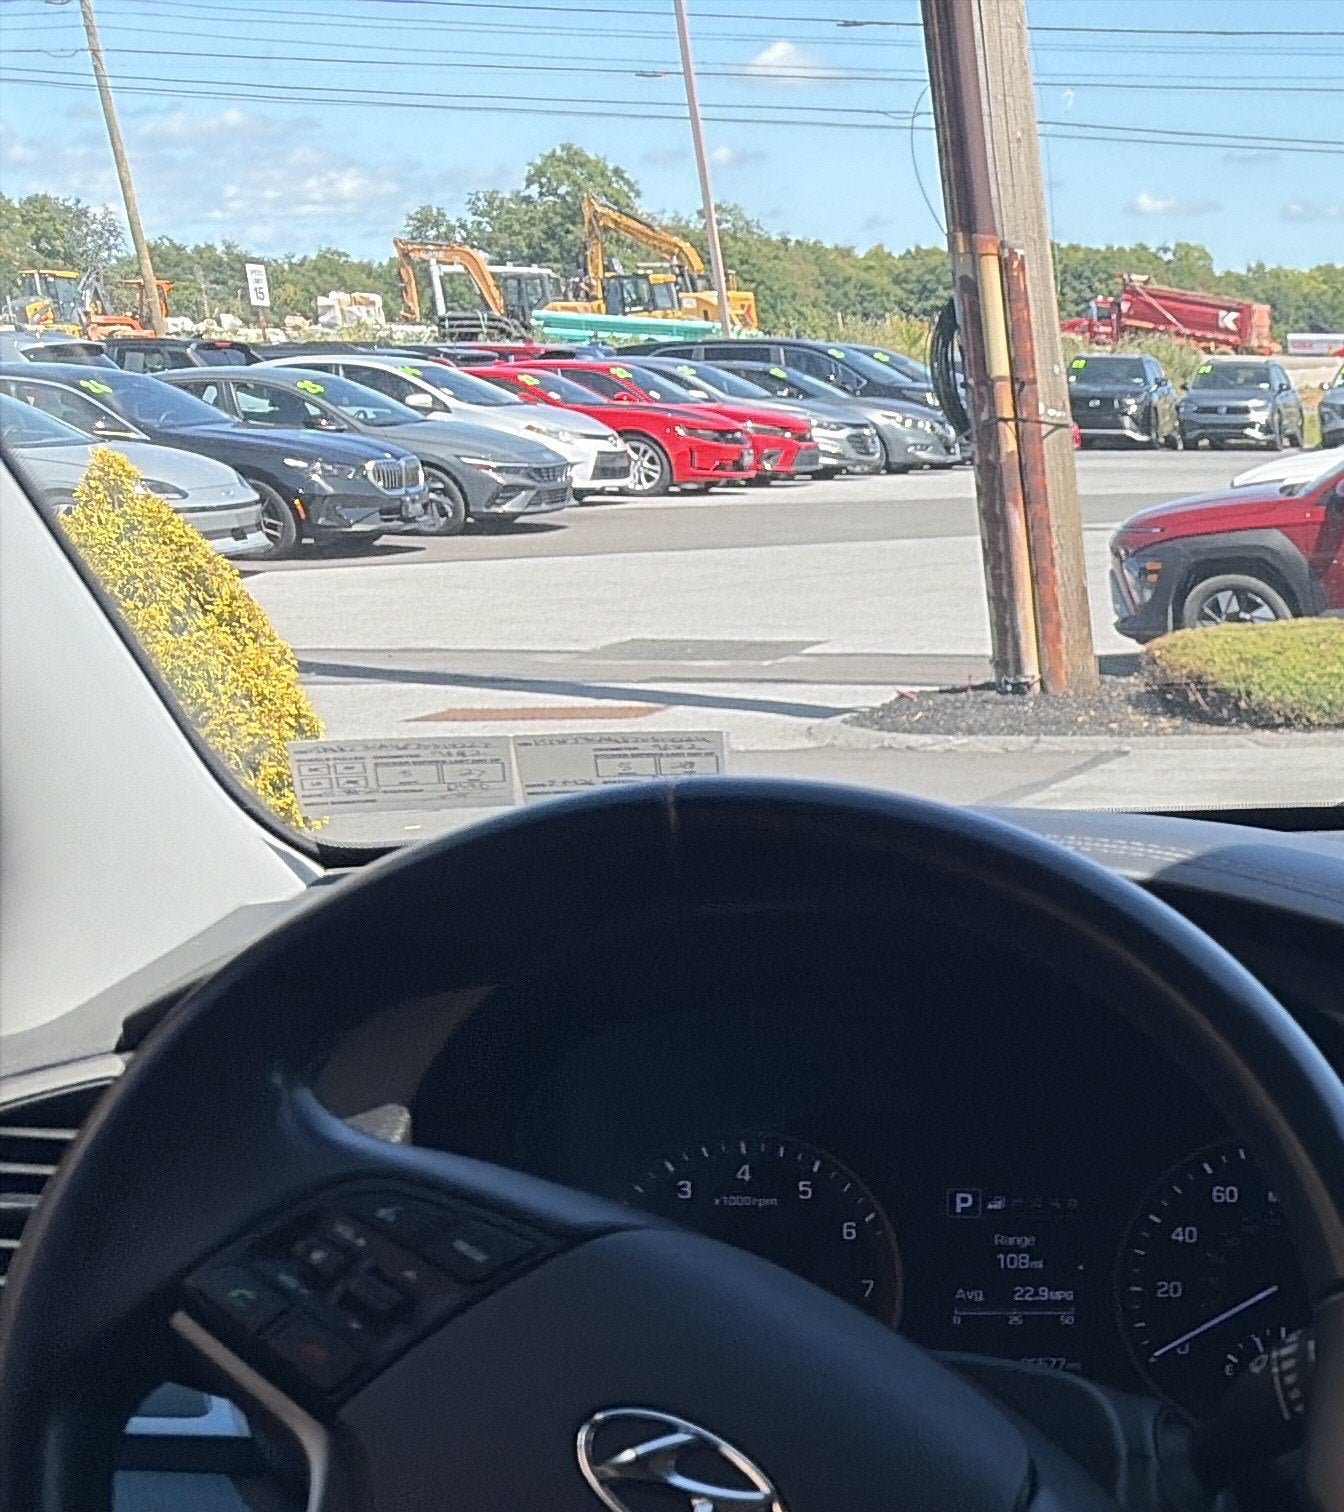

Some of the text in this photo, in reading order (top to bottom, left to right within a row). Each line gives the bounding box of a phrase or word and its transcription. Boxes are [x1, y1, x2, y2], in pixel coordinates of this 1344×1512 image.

[254, 286, 265, 301] 15
[736, 1164, 752, 1182] 4
[677, 1180, 693, 1199] 3
[798, 1181, 813, 1200] 5
[1211, 1185, 1239, 1203] 60
[955, 1192, 974, 1214] P
[842, 1221, 857, 1240] 6
[1169, 1226, 1198, 1243] 40
[993, 1233, 1037, 1249] Range
[861, 1279, 875, 1297] 7
[1155, 1281, 1183, 1298] 20
